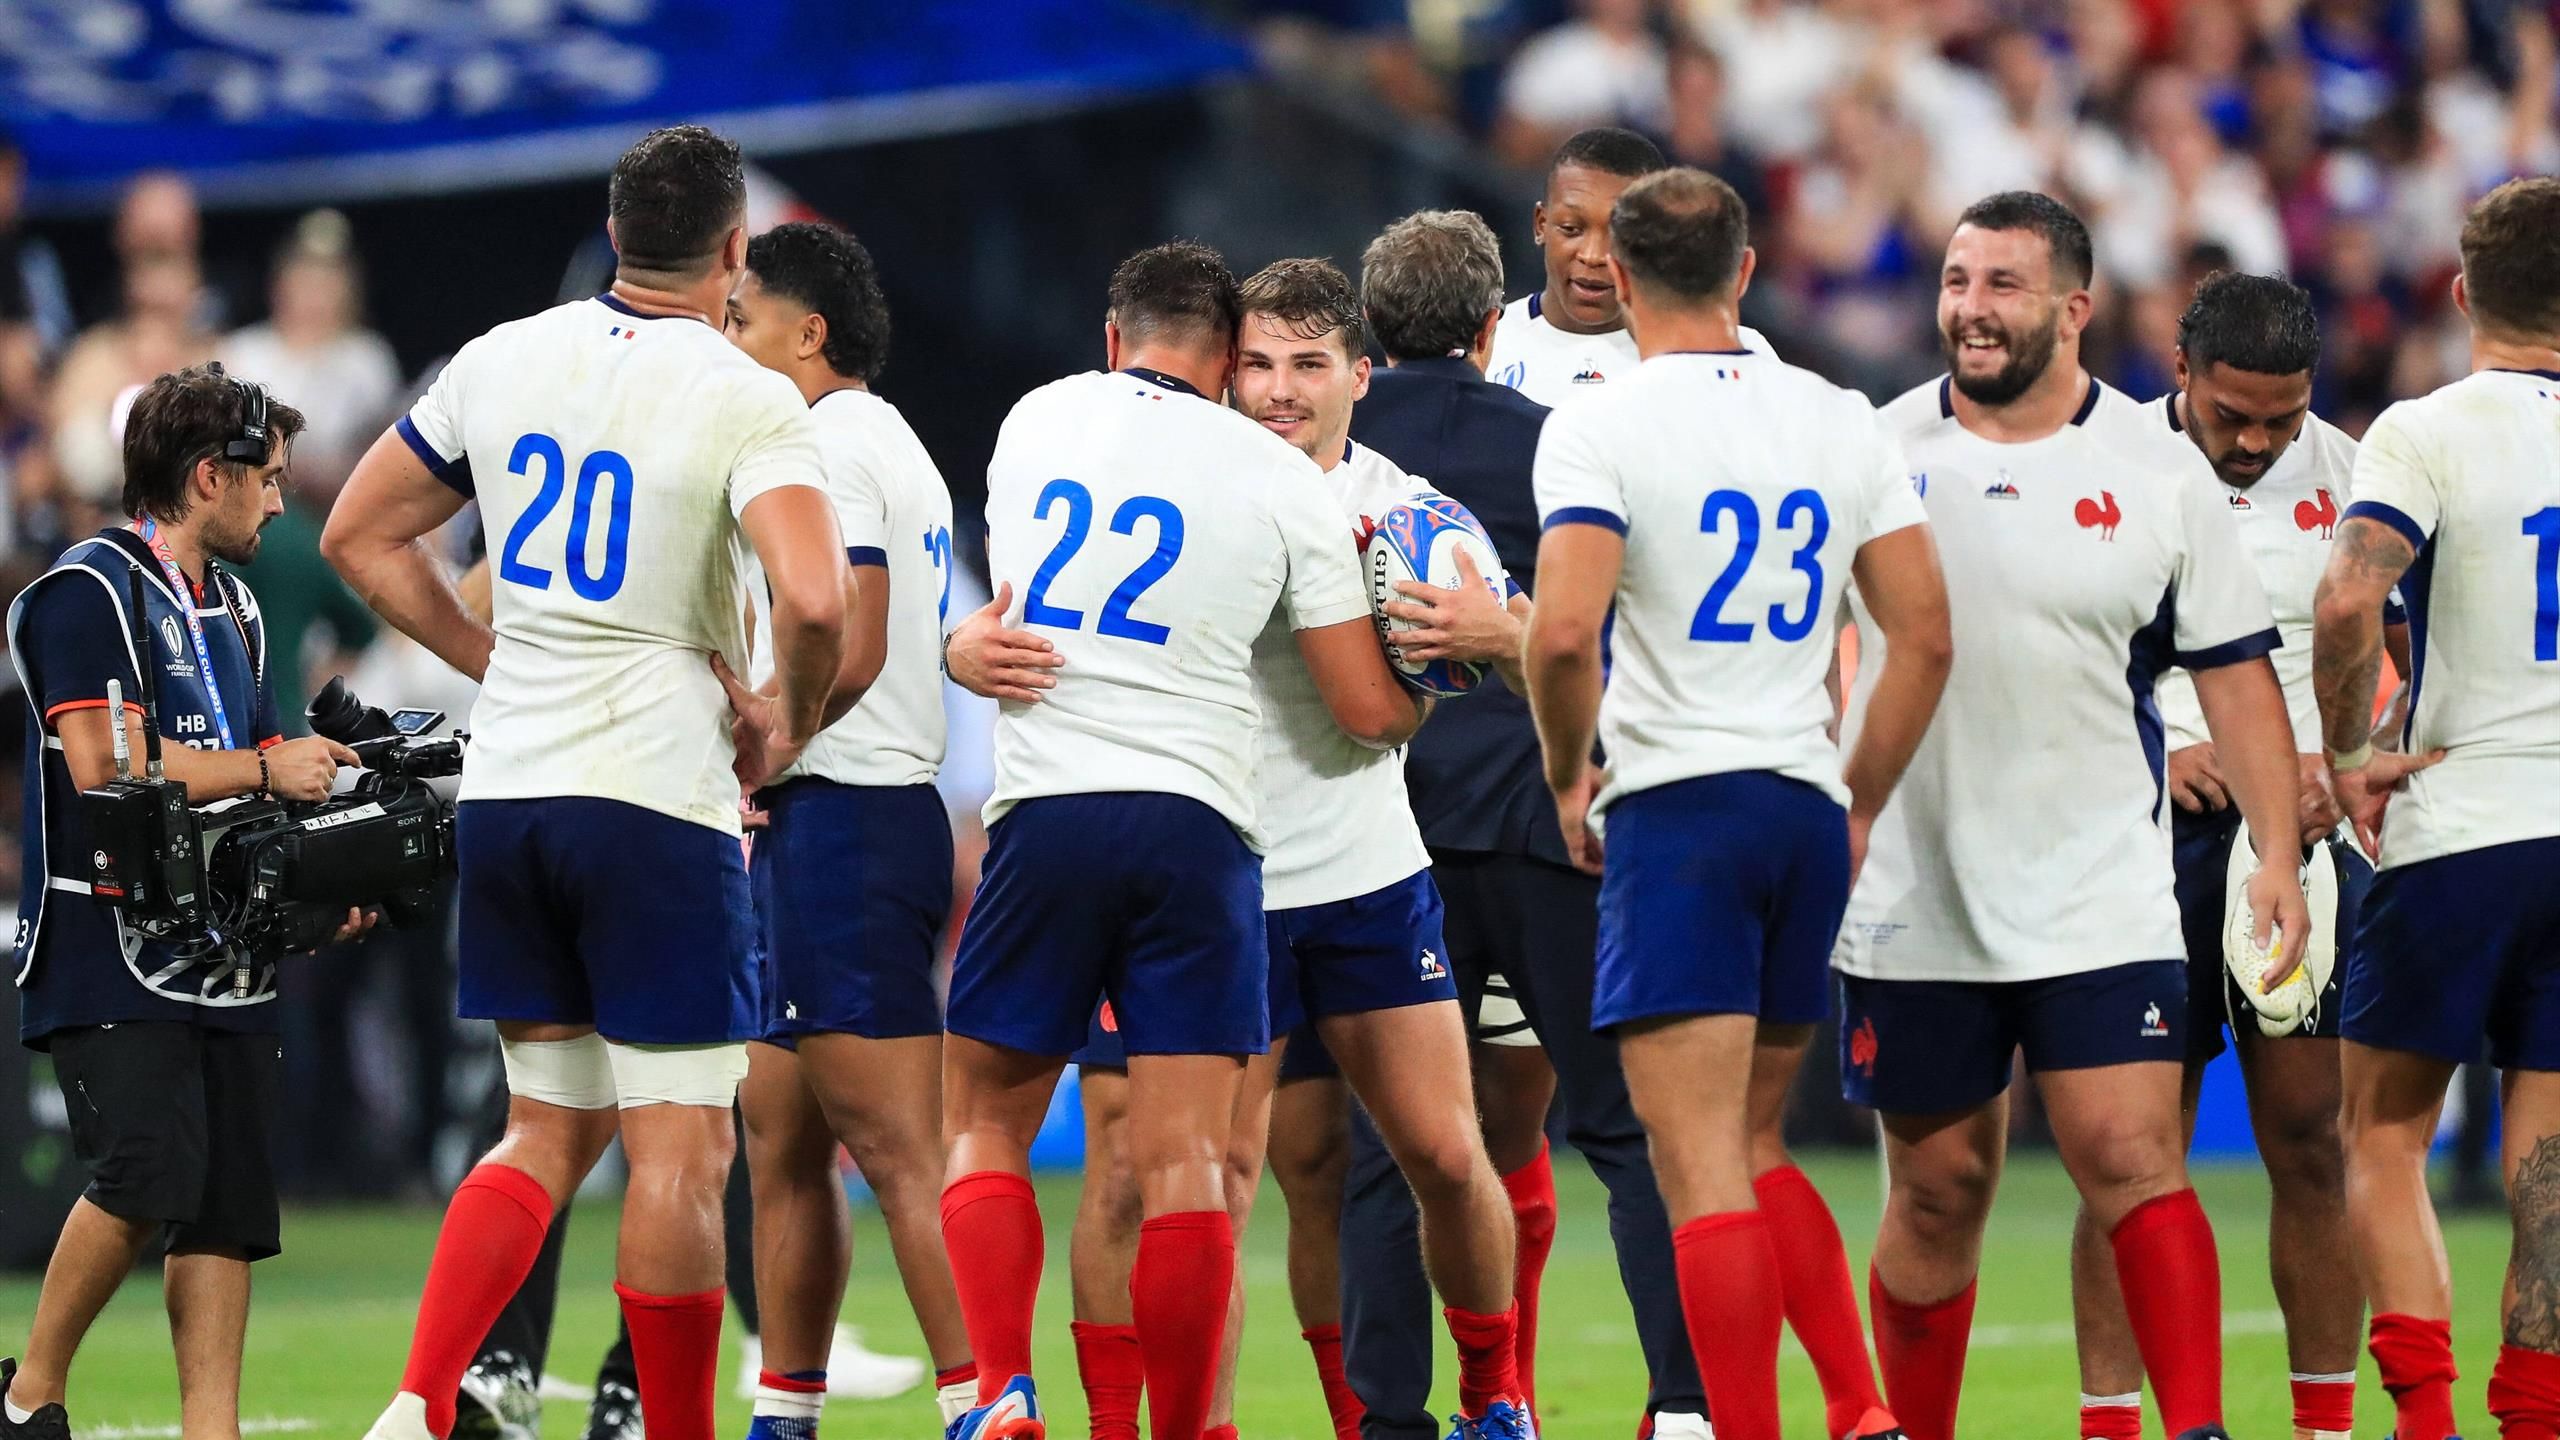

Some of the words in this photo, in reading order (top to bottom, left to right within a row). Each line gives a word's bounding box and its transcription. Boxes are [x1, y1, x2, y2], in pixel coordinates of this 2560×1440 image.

[500, 433, 634, 603] 20
[1024, 479, 1185, 646] 22
[1689, 489, 1830, 643] 23
[167, 568, 192, 611] RUGBY
[187, 610, 206, 656] WORLD
[201, 658, 214, 684] CUP
[208, 684, 223, 714] 2023
[176, 714, 207, 733] HB
[397, 815, 422, 827] SONY
